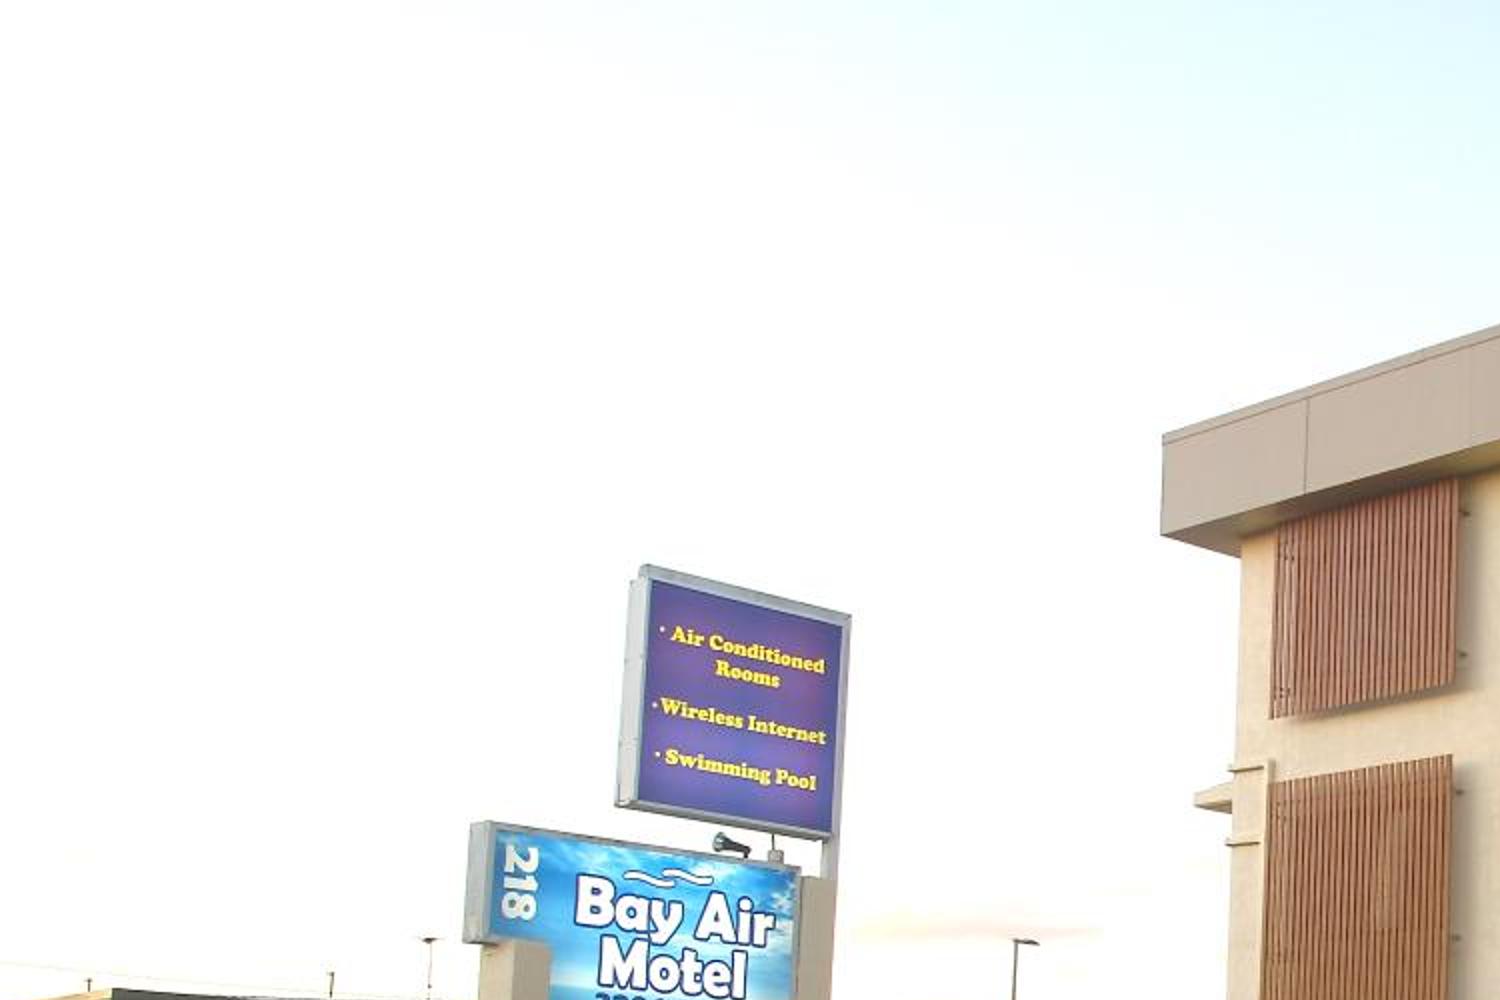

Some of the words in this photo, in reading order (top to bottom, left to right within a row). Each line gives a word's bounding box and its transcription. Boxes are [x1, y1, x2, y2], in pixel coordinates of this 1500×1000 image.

[671, 625, 704, 646] Air
[709, 635, 825, 674] Conditioned
[715, 659, 781, 688] Rooms
[661, 697, 743, 728] Wireless
[748, 715, 826, 744] Internet
[665, 748, 771, 785] Swimming
[776, 768, 816, 791] Pool
[502, 846, 539, 921] 218
[575, 874, 684, 945] Bay
[695, 890, 776, 947] Air
[598, 934, 748, 1000] Motel
